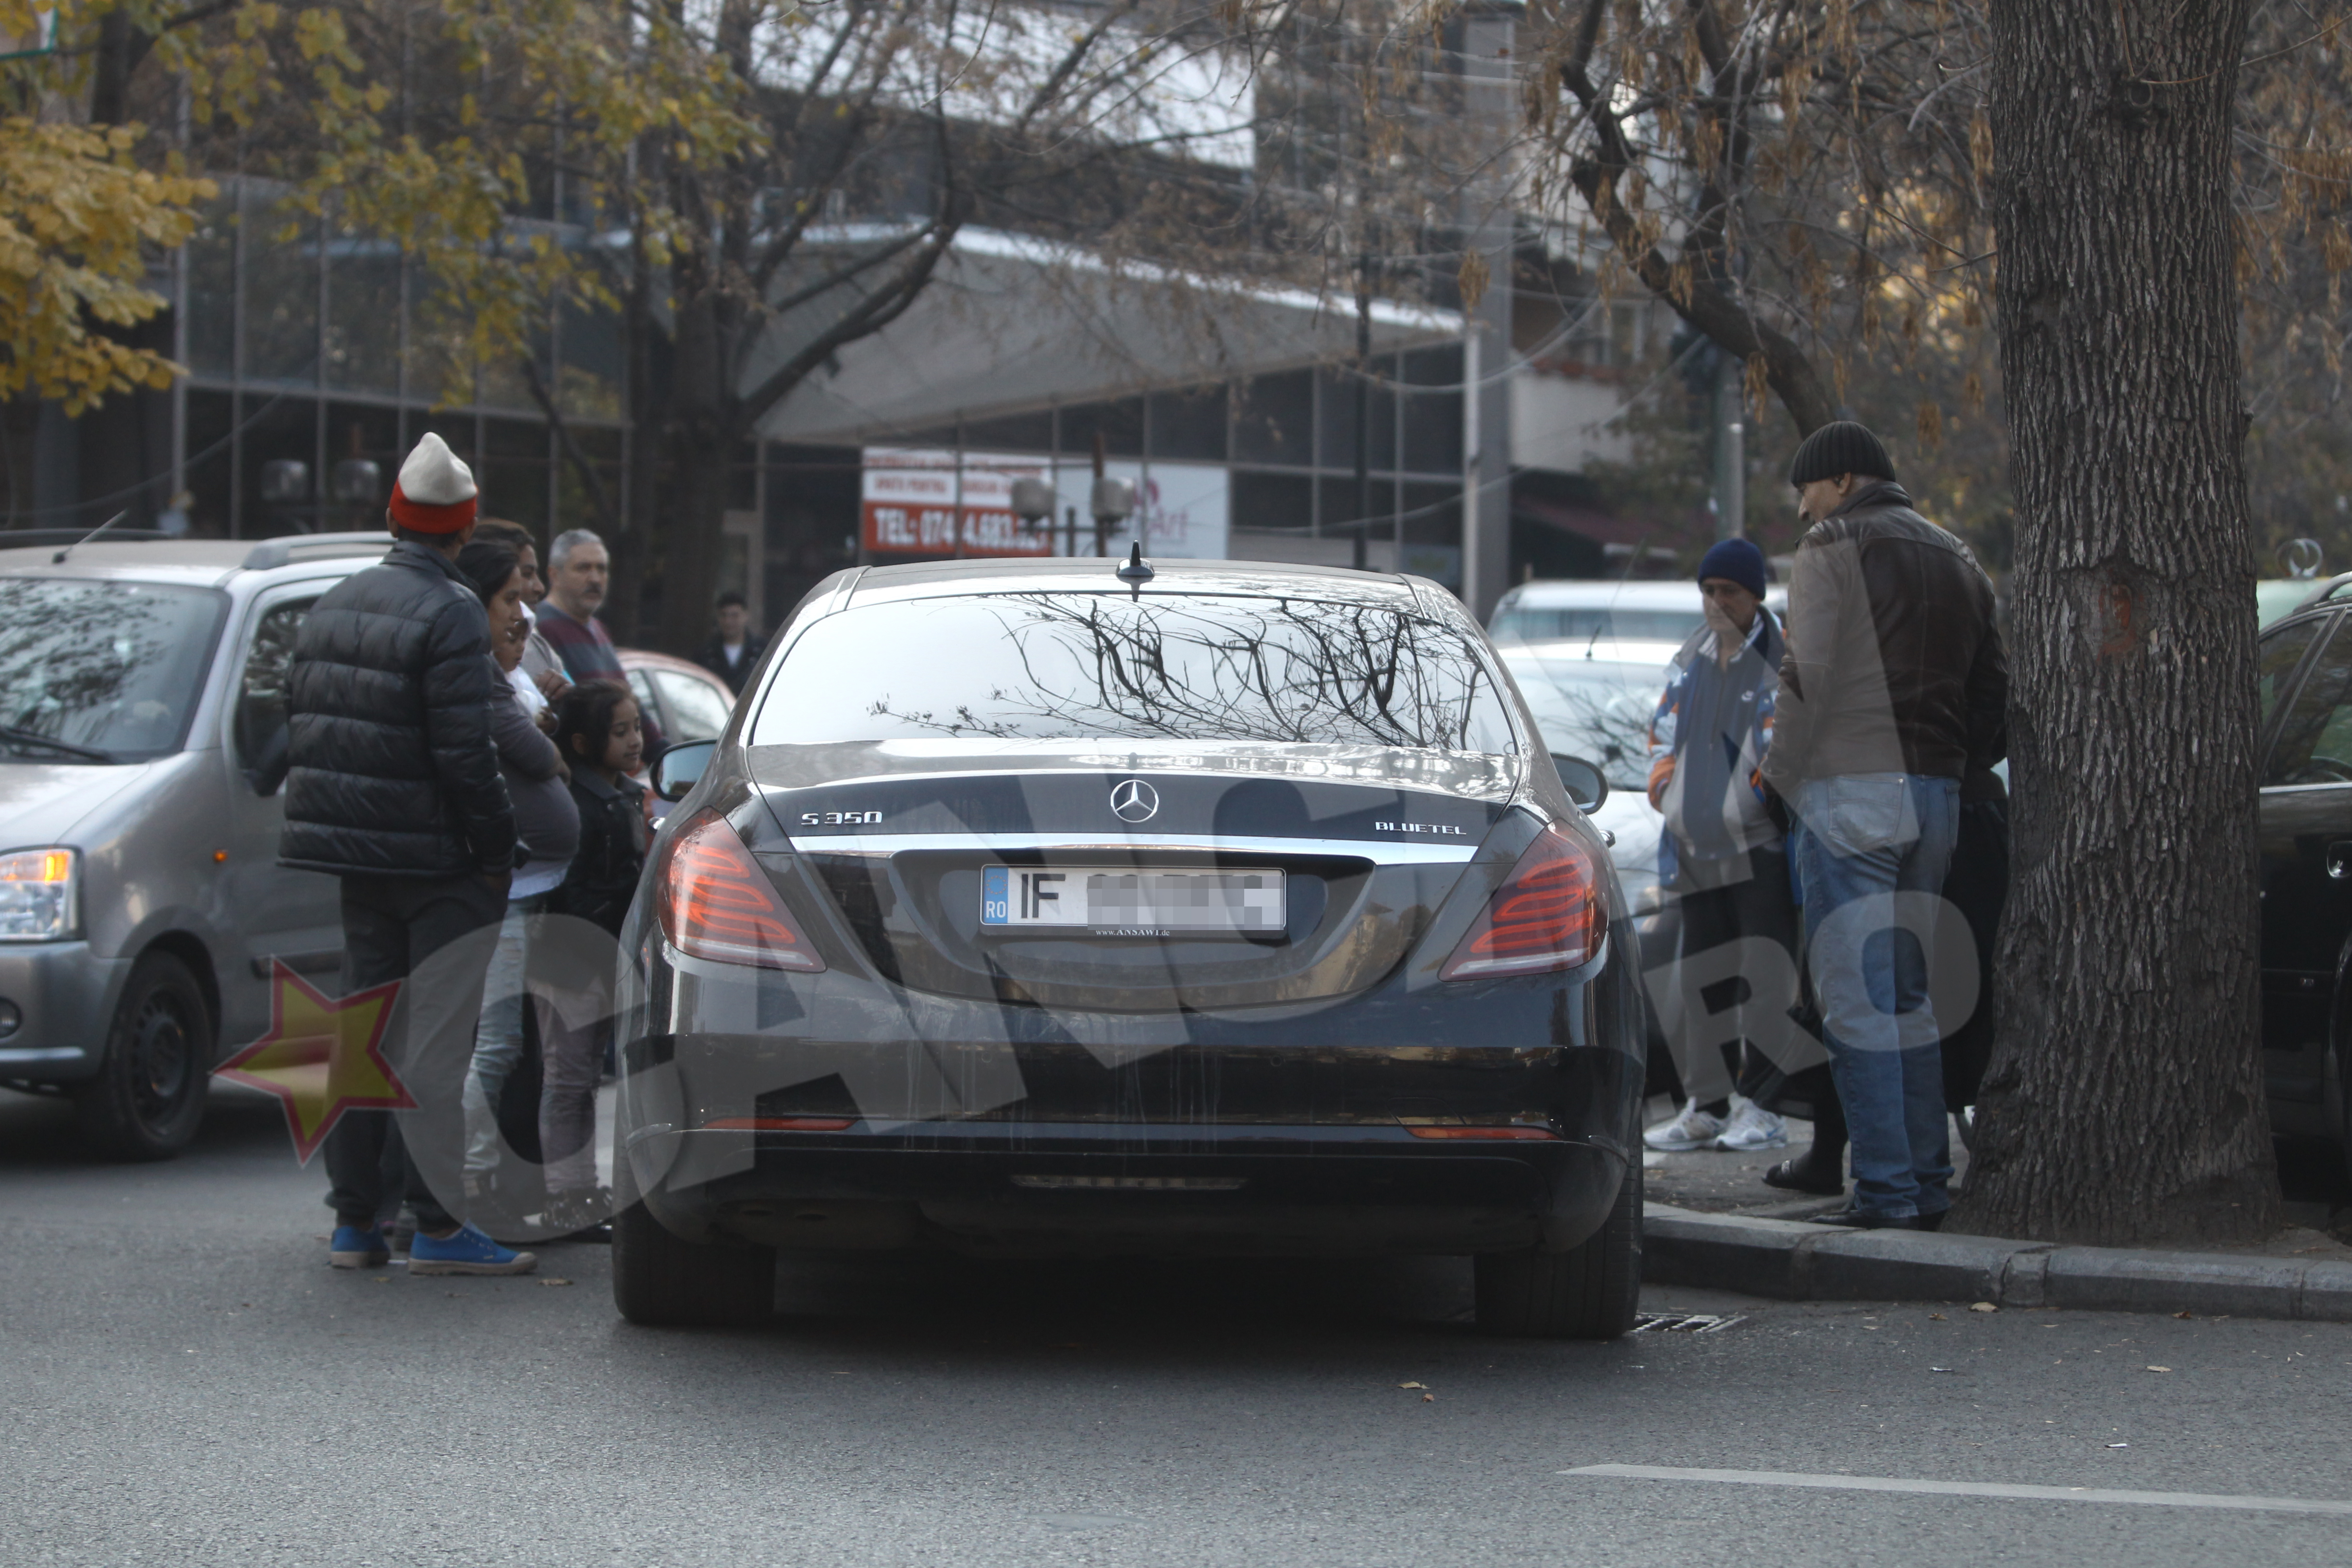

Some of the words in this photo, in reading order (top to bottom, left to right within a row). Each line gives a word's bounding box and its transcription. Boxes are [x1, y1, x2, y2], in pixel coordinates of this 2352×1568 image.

[801, 813, 819, 826] S
[824, 811, 882, 825] 350
[1020, 873, 1066, 919] IF
[986, 901, 1006, 918] RO
